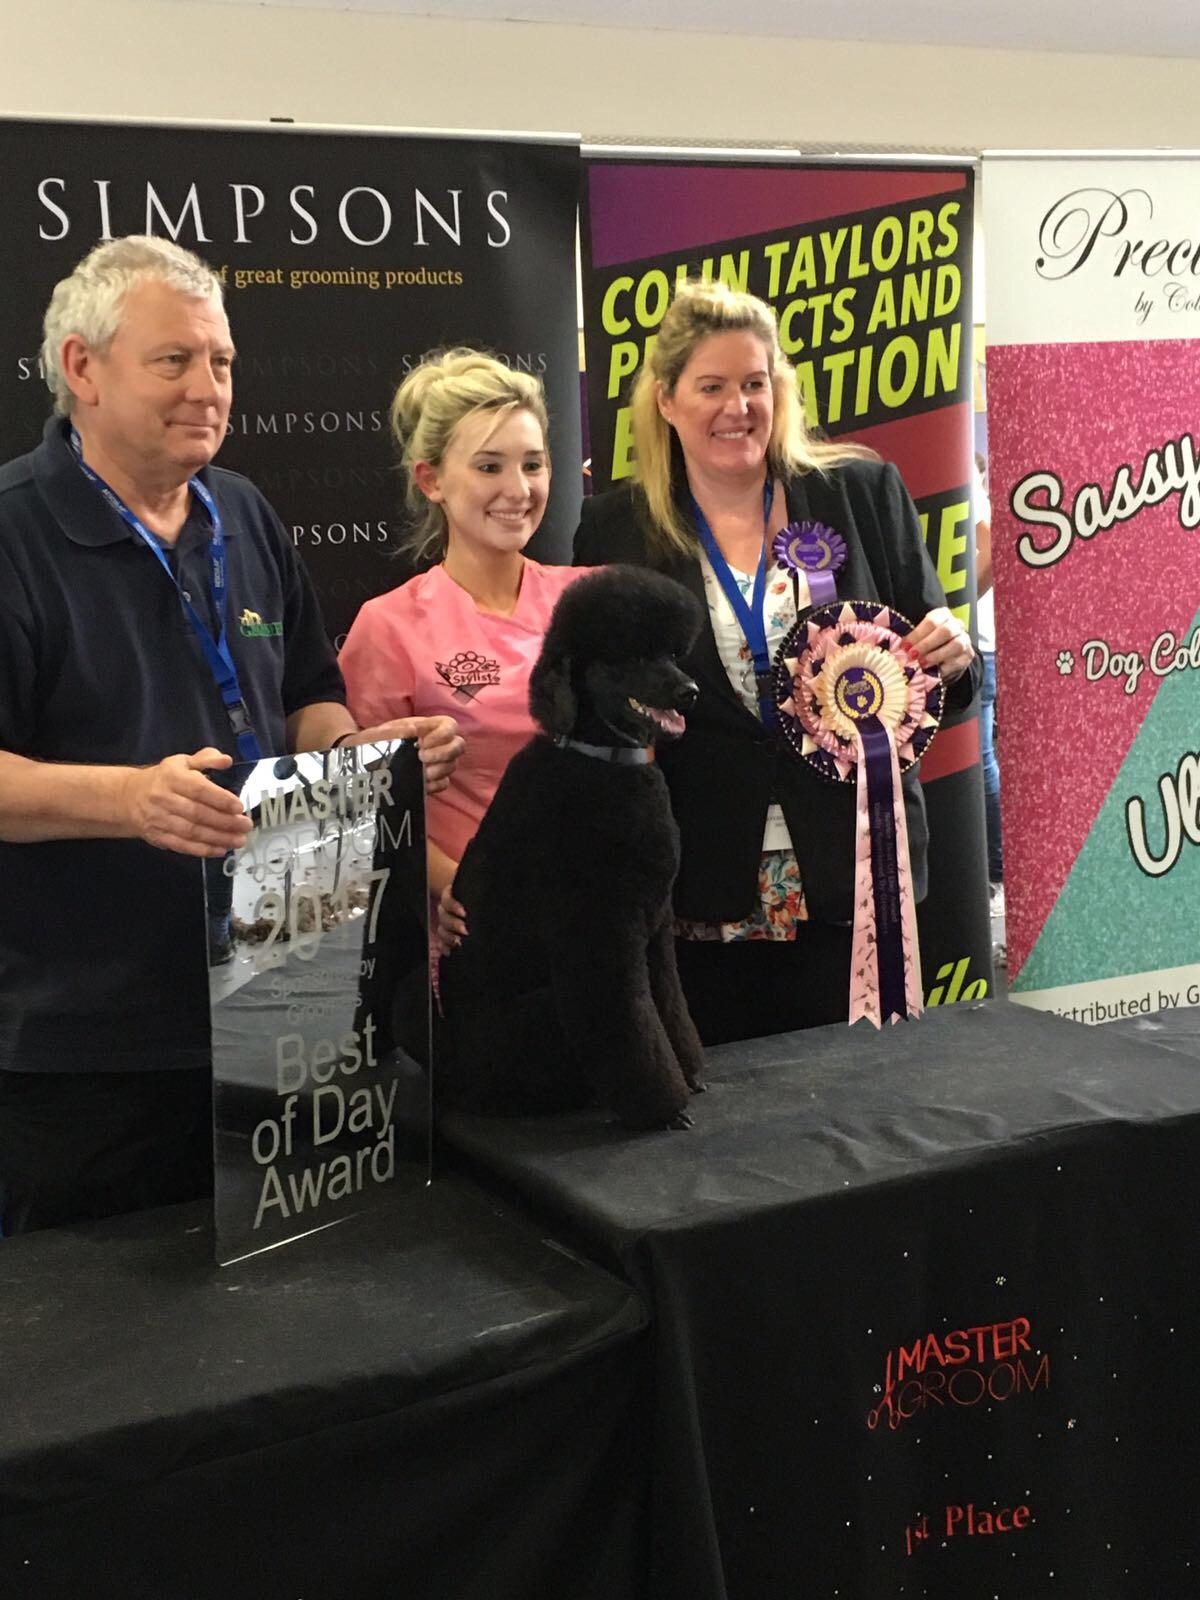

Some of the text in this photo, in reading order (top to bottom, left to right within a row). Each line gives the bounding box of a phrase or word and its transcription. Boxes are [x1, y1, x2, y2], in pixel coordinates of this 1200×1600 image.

[37, 176, 511, 249] SIMPSONS
[235, 267, 284, 289] great
[290, 266, 380, 289] grooming
[385, 266, 463, 289] products
[764, 202, 960, 298] TAYLORS
[866, 264, 961, 335] AND
[1134, 290, 1154, 326] by
[292, 520, 388, 547] PSONS
[1010, 432, 1200, 570] Sassy
[1081, 639, 1143, 695] Dog
[261, 768, 395, 830] MASTER
[254, 867, 390, 969] 2017
[277, 1013, 377, 1096] Best
[252, 1078, 398, 1165] of Day
[253, 1124, 395, 1229] Award
[899, 1317, 1031, 1381] MASTER
[898, 1354, 1050, 1418] GROOM
[946, 1503, 1031, 1537] Place
